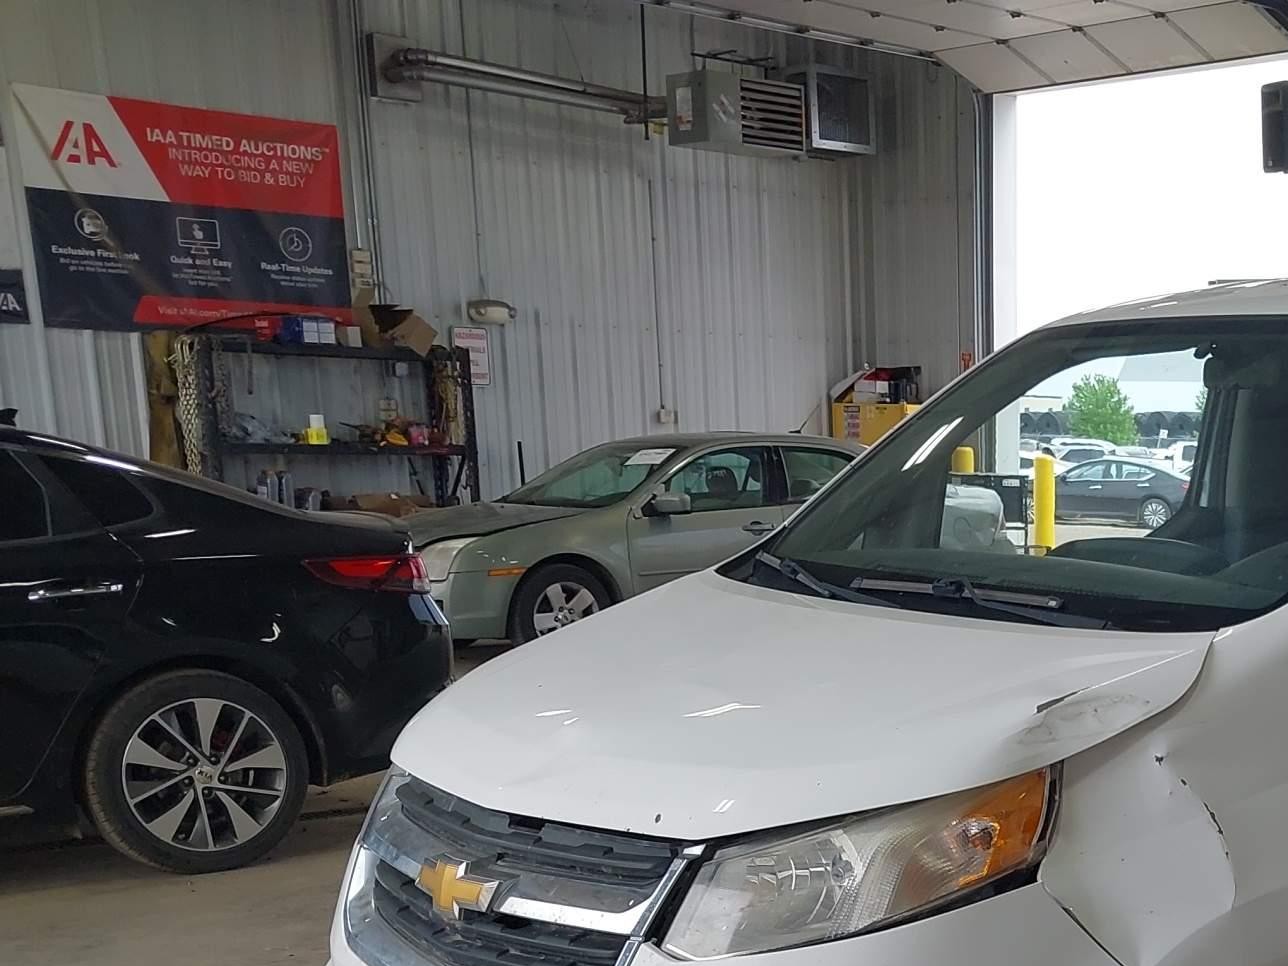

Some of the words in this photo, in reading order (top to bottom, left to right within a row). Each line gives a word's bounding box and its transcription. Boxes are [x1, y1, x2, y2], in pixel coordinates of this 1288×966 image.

[146, 127, 177, 144] IAA
[178, 131, 234, 151] TIMED
[168, 147, 266, 169] INTRODUCING
[269, 158, 279, 171] A
[282, 160, 314, 175] NEW
[178, 163, 212, 178] WAY
[215, 167, 235, 180] TO
[238, 171, 261, 183] BID
[263, 173, 276, 185] &
[278, 174, 306, 188] BUY
[50, 244, 95, 257] Exclusive
[170, 255, 193, 264] Quick
[195, 257, 211, 265] and
[212, 257, 233, 268] Easy
[260, 261, 301, 273] Real-Time
[302, 265, 333, 275] Updates
